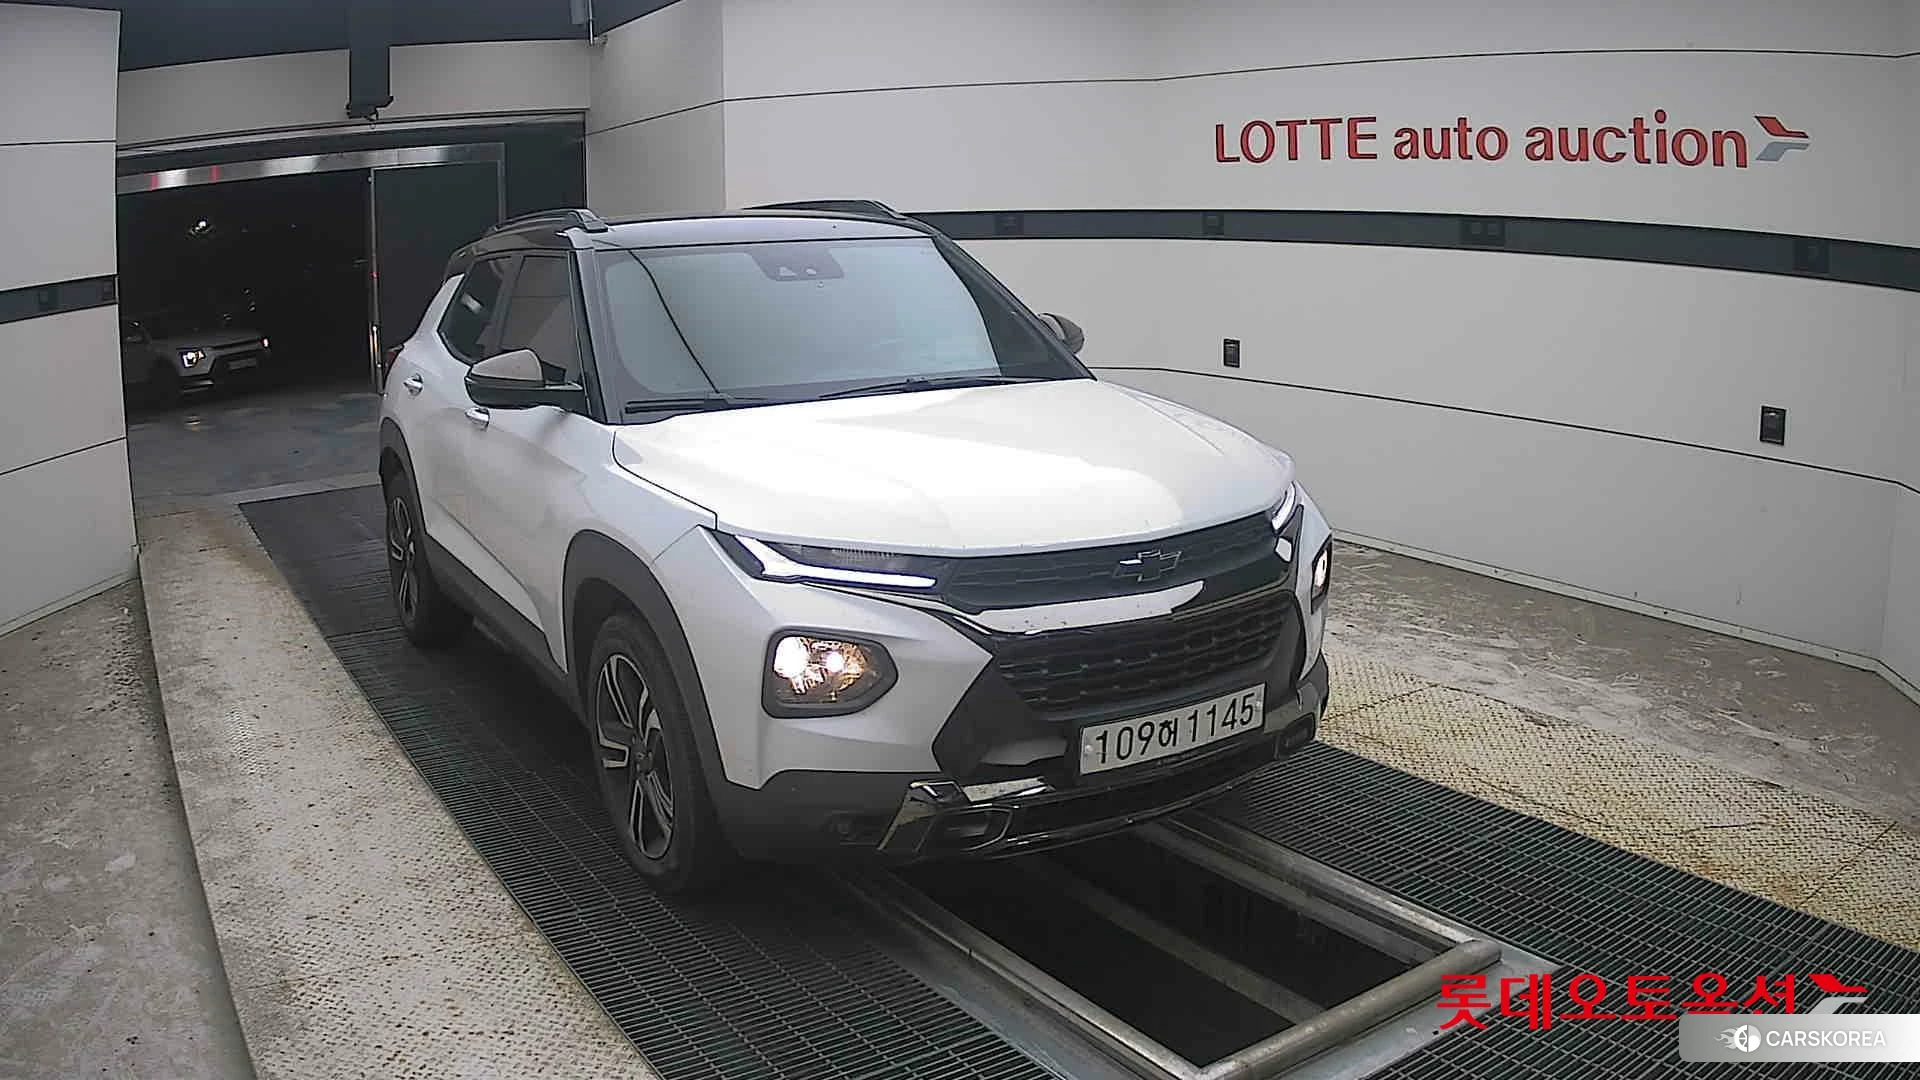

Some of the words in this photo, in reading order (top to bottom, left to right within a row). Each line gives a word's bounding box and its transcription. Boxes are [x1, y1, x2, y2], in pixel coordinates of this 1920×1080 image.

[1216, 116, 1377, 163] LOTTE
[1392, 116, 1510, 161] auto
[1524, 109, 1748, 168] auction
